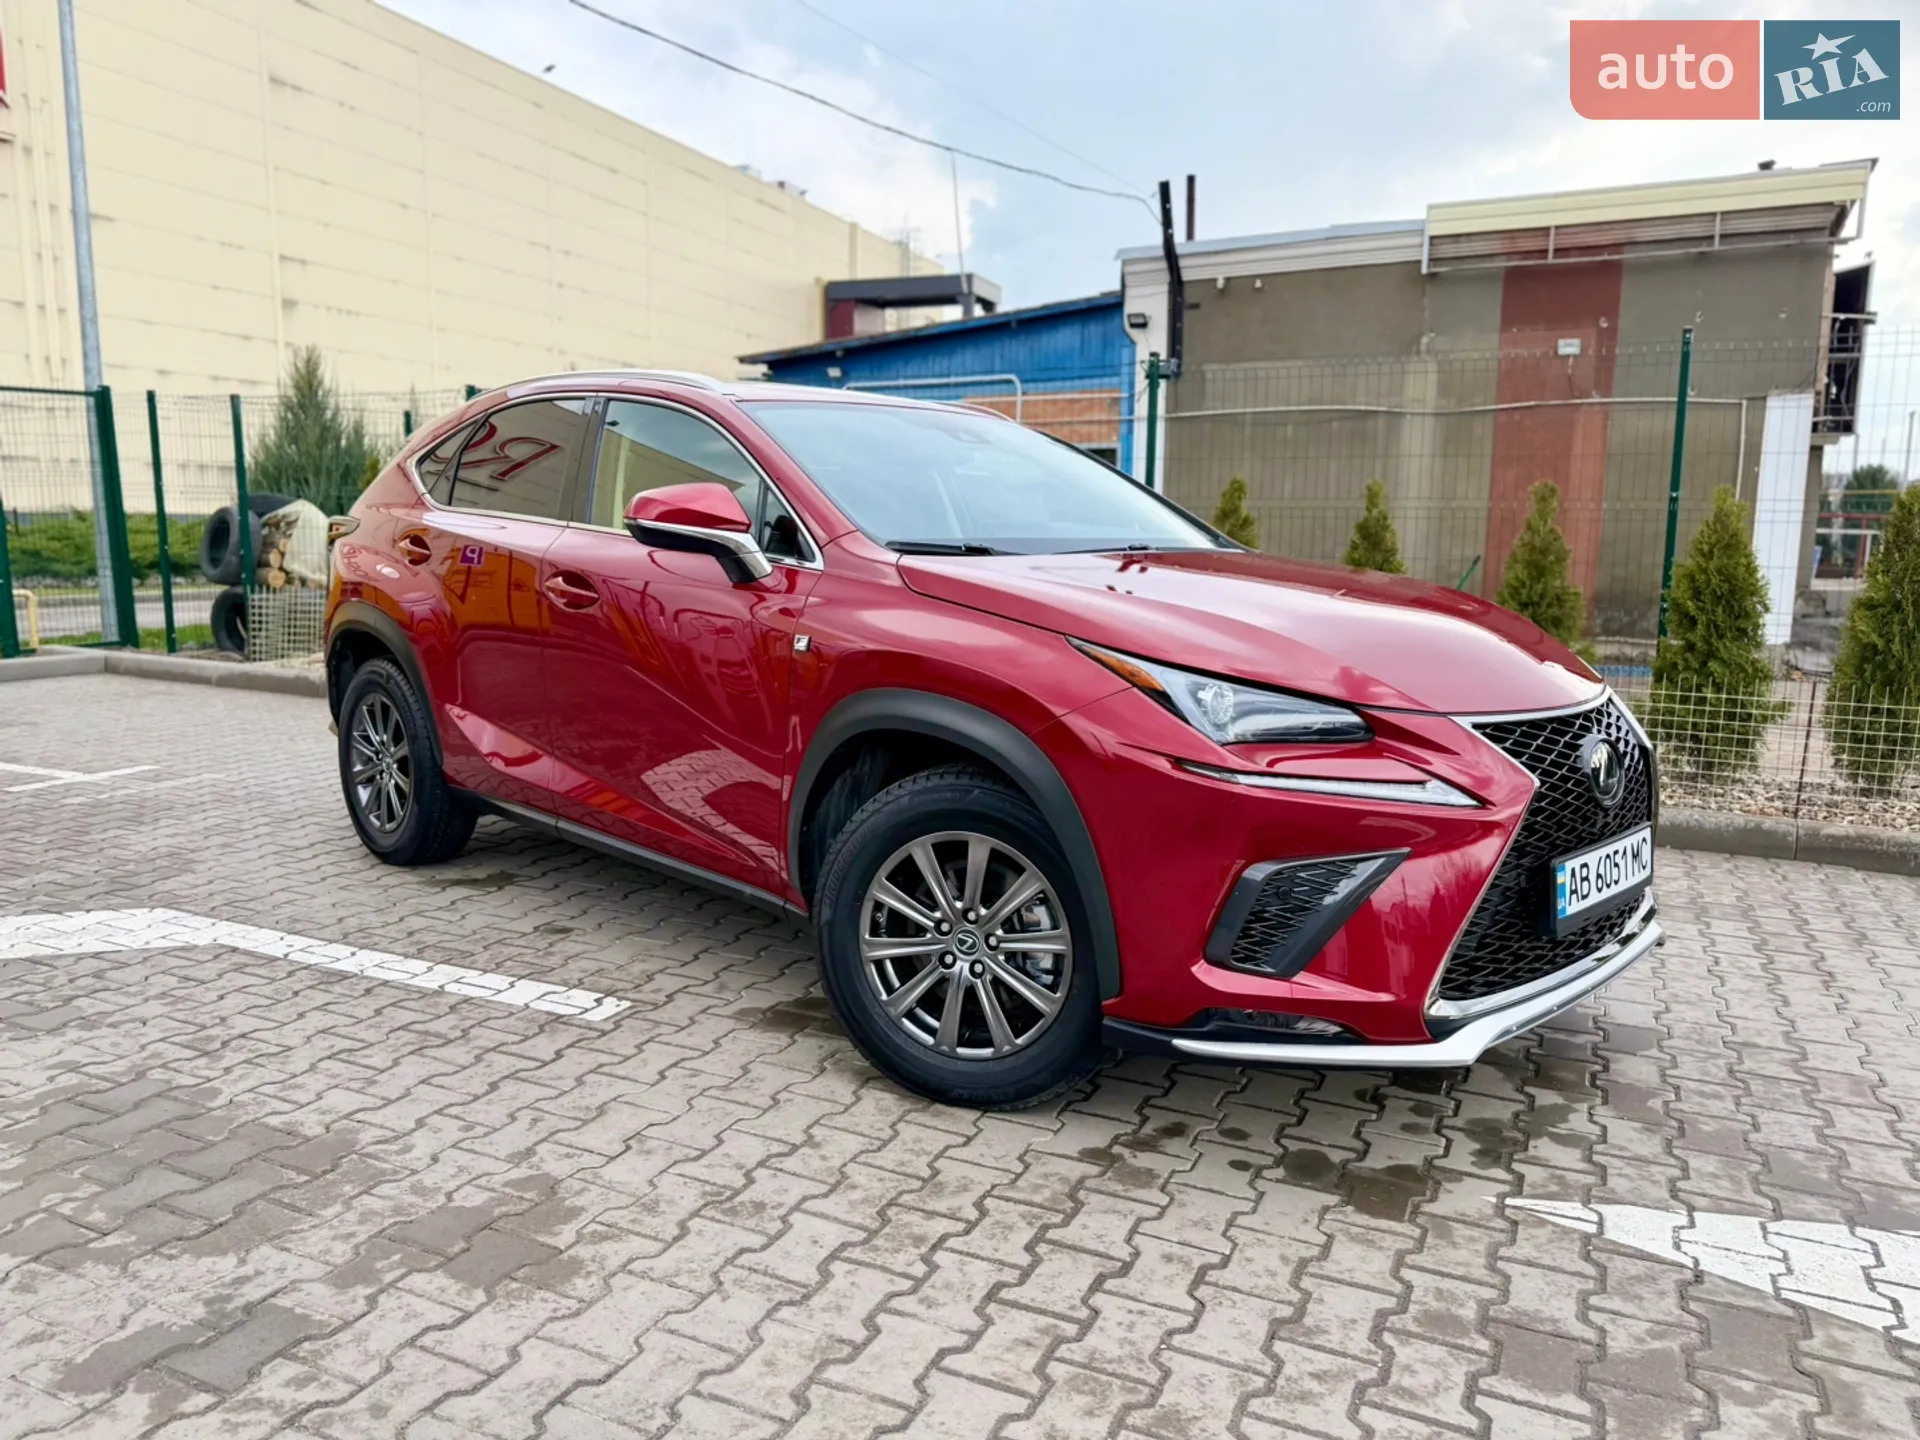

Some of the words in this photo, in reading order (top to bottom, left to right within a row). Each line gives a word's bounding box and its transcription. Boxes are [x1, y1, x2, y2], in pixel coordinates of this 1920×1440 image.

[1568, 861, 1591, 907] AB
[1595, 846, 1628, 894] 6051
[1630, 836, 1648, 878] MC
